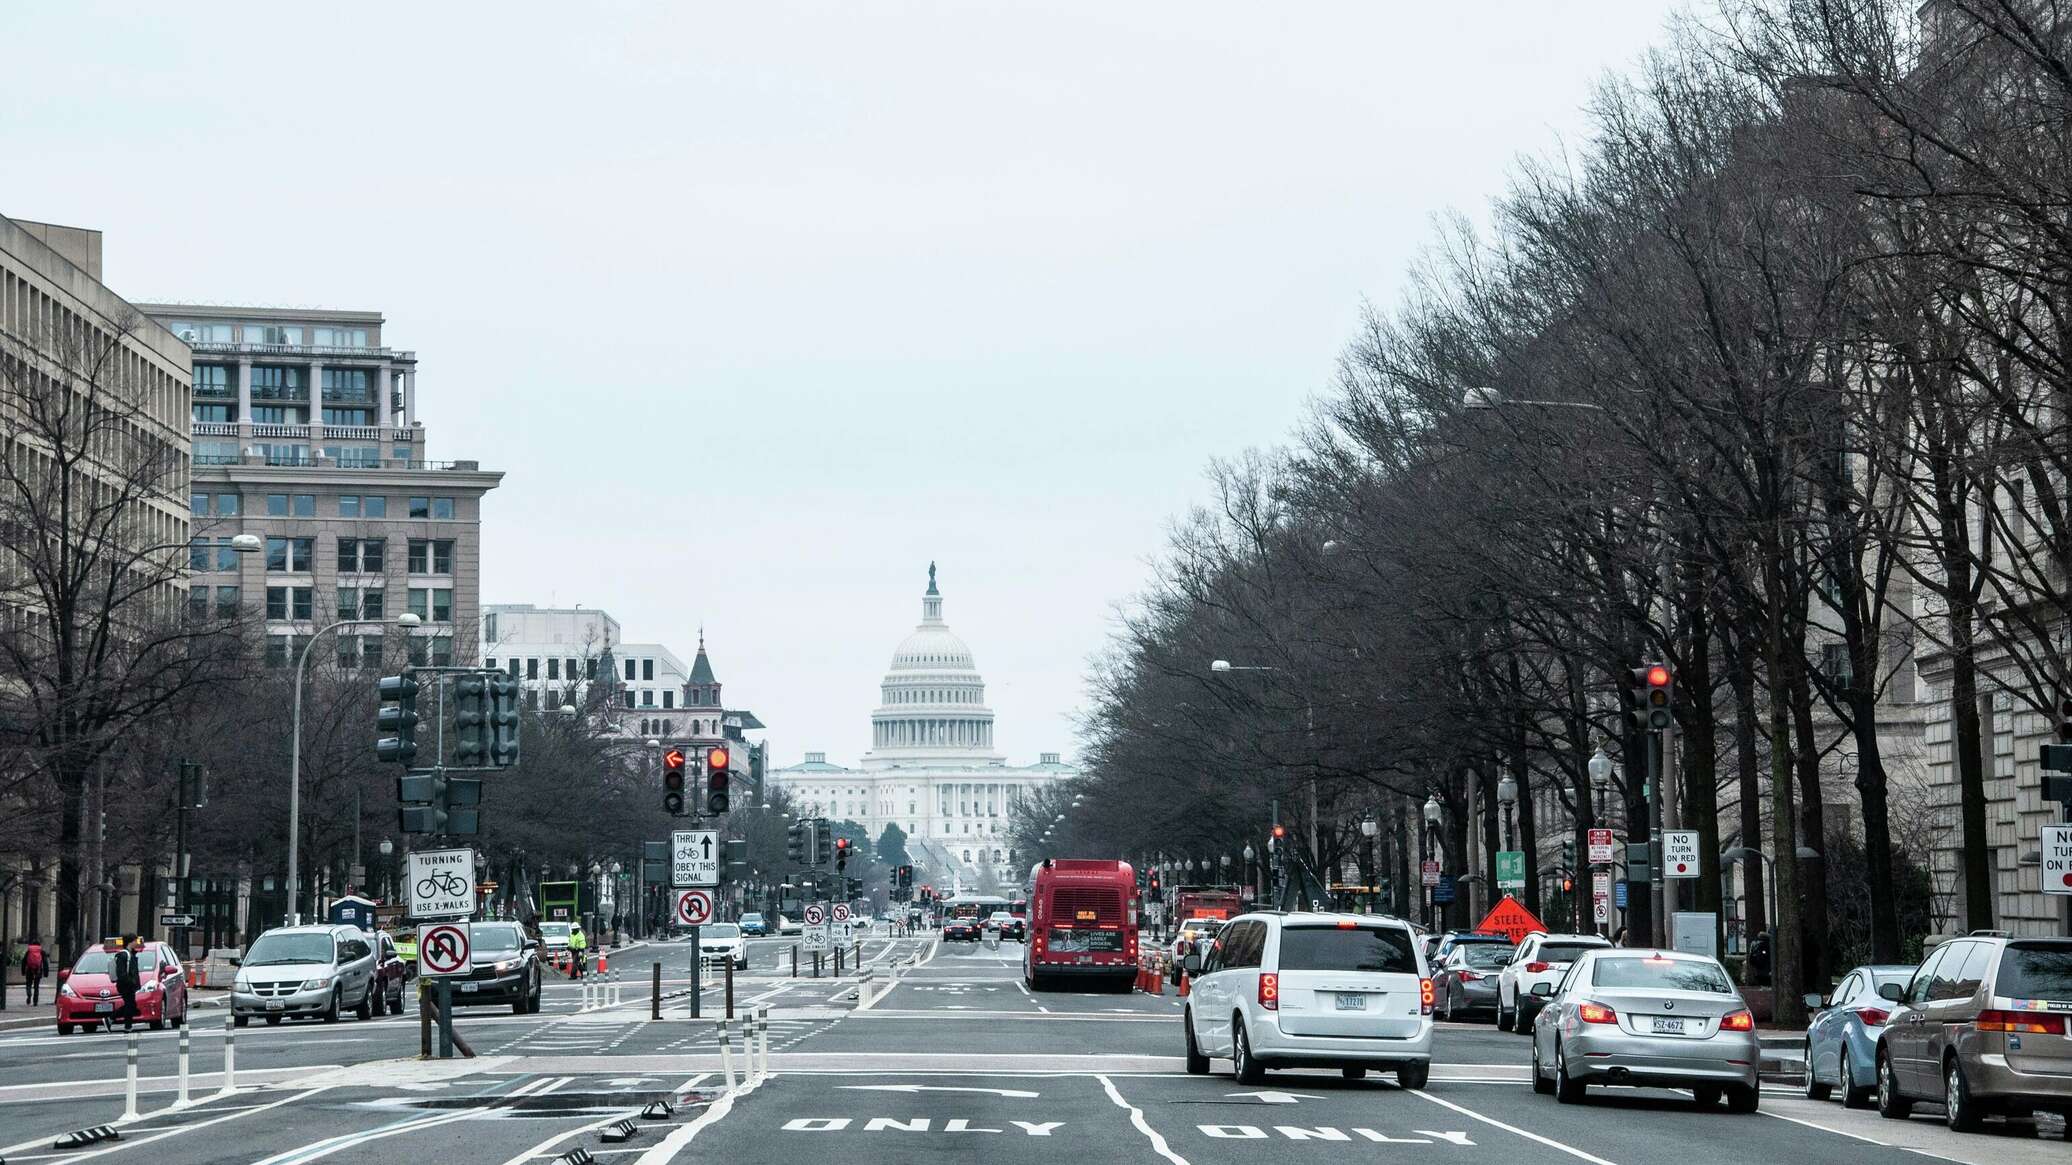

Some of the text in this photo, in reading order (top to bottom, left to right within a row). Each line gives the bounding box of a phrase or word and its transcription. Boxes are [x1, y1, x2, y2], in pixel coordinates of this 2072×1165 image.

[676, 834, 696, 843] THRU
[1673, 835, 1688, 844] NO
[2057, 831, 2072, 843] N
[419, 854, 463, 865] TURNING
[1666, 854, 1696, 862] ON RED
[675, 862, 716, 871] OBEY THIS
[2047, 860, 2063, 870] ON
[675, 873, 703, 882] SIGNAL
[417, 900, 469, 912] USE X-WALKS
[1494, 915, 1525, 925] STEEL
[780, 1118, 1067, 1136] ONLY
[1196, 1125, 1478, 1146] ONLY
